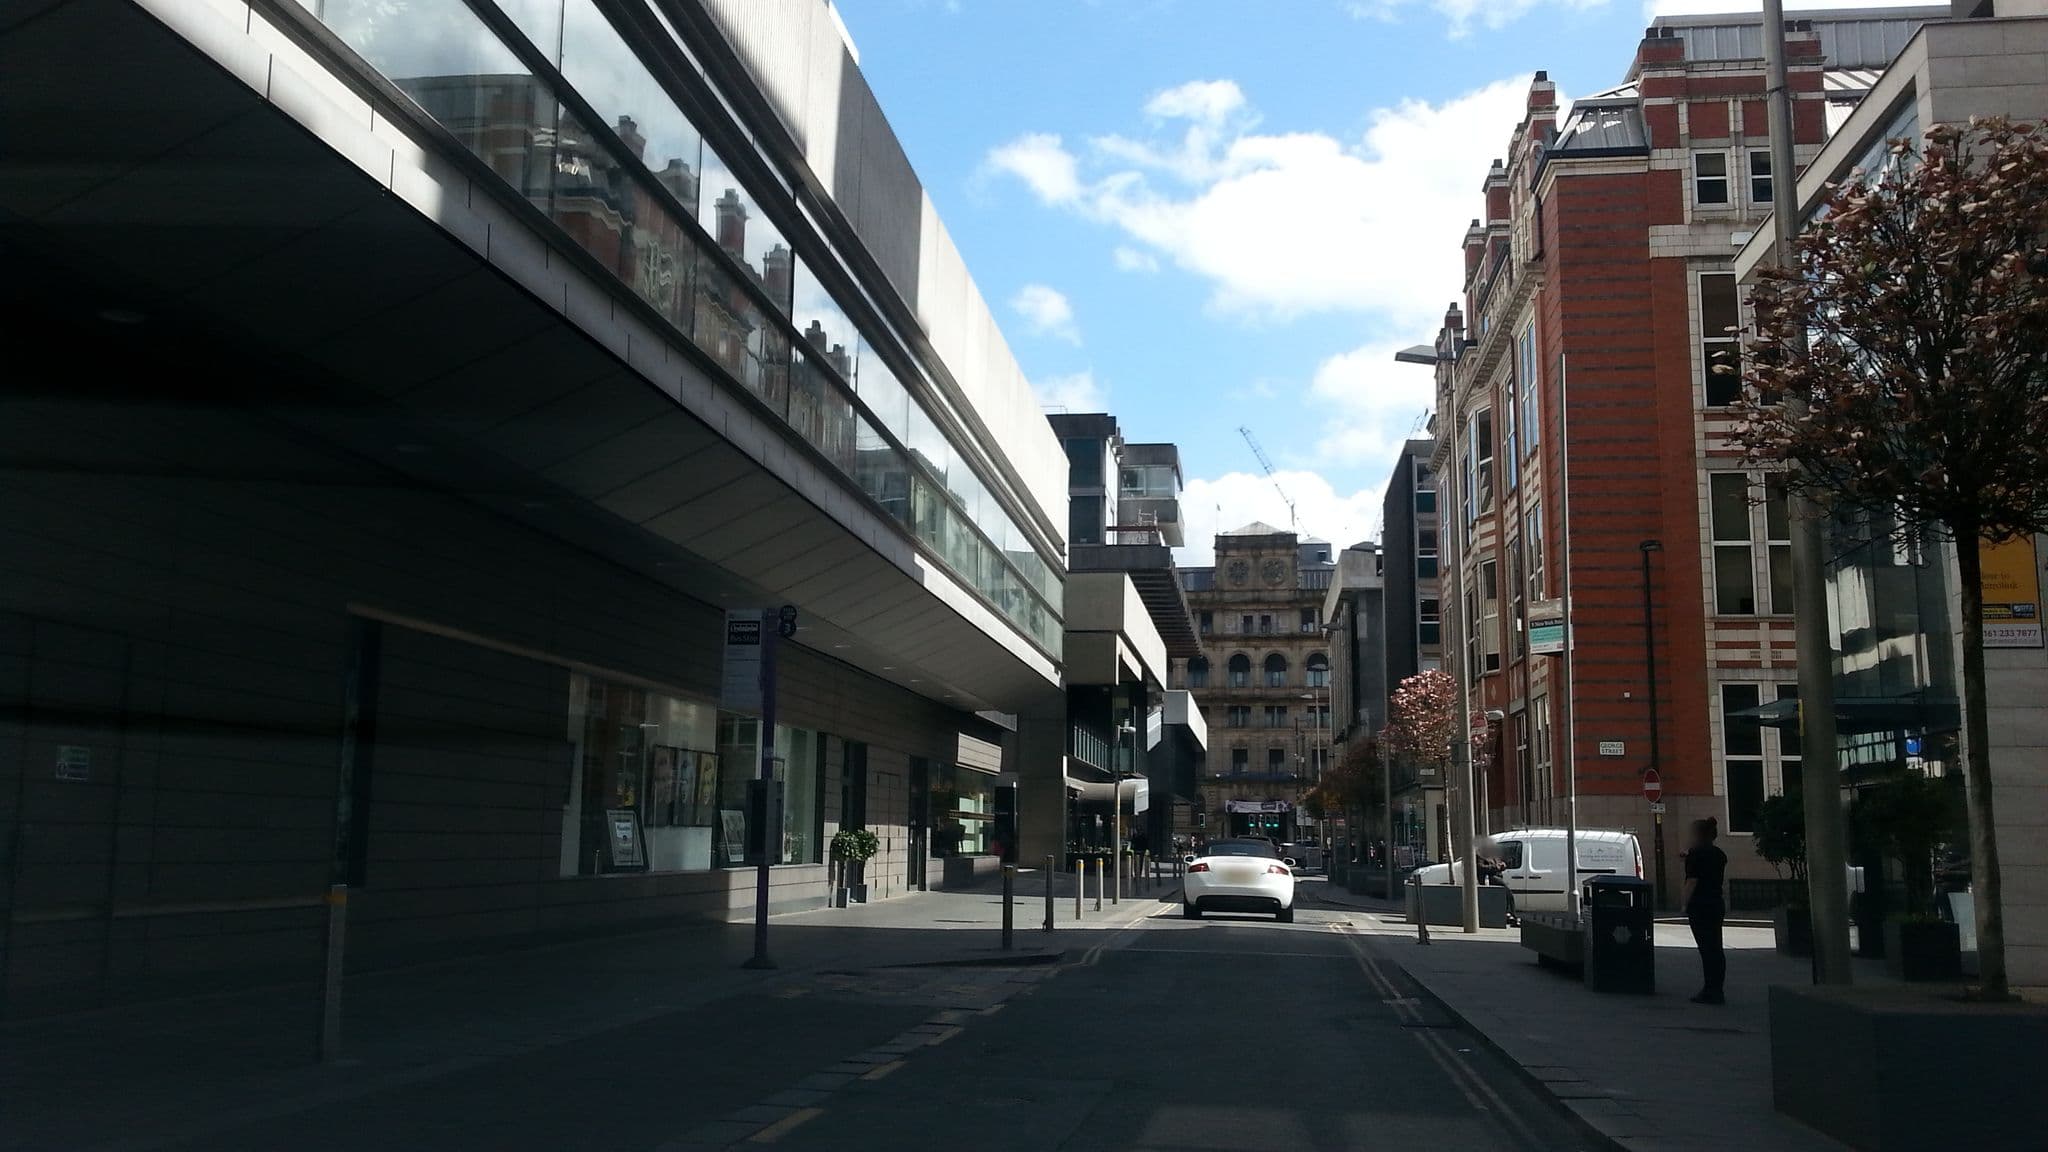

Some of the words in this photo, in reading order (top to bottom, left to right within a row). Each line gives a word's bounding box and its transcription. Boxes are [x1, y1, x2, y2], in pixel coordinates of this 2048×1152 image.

[1984, 629, 1997, 638] 161
[1999, 629, 2015, 637] 233
[2015, 629, 2037, 637] 7877
